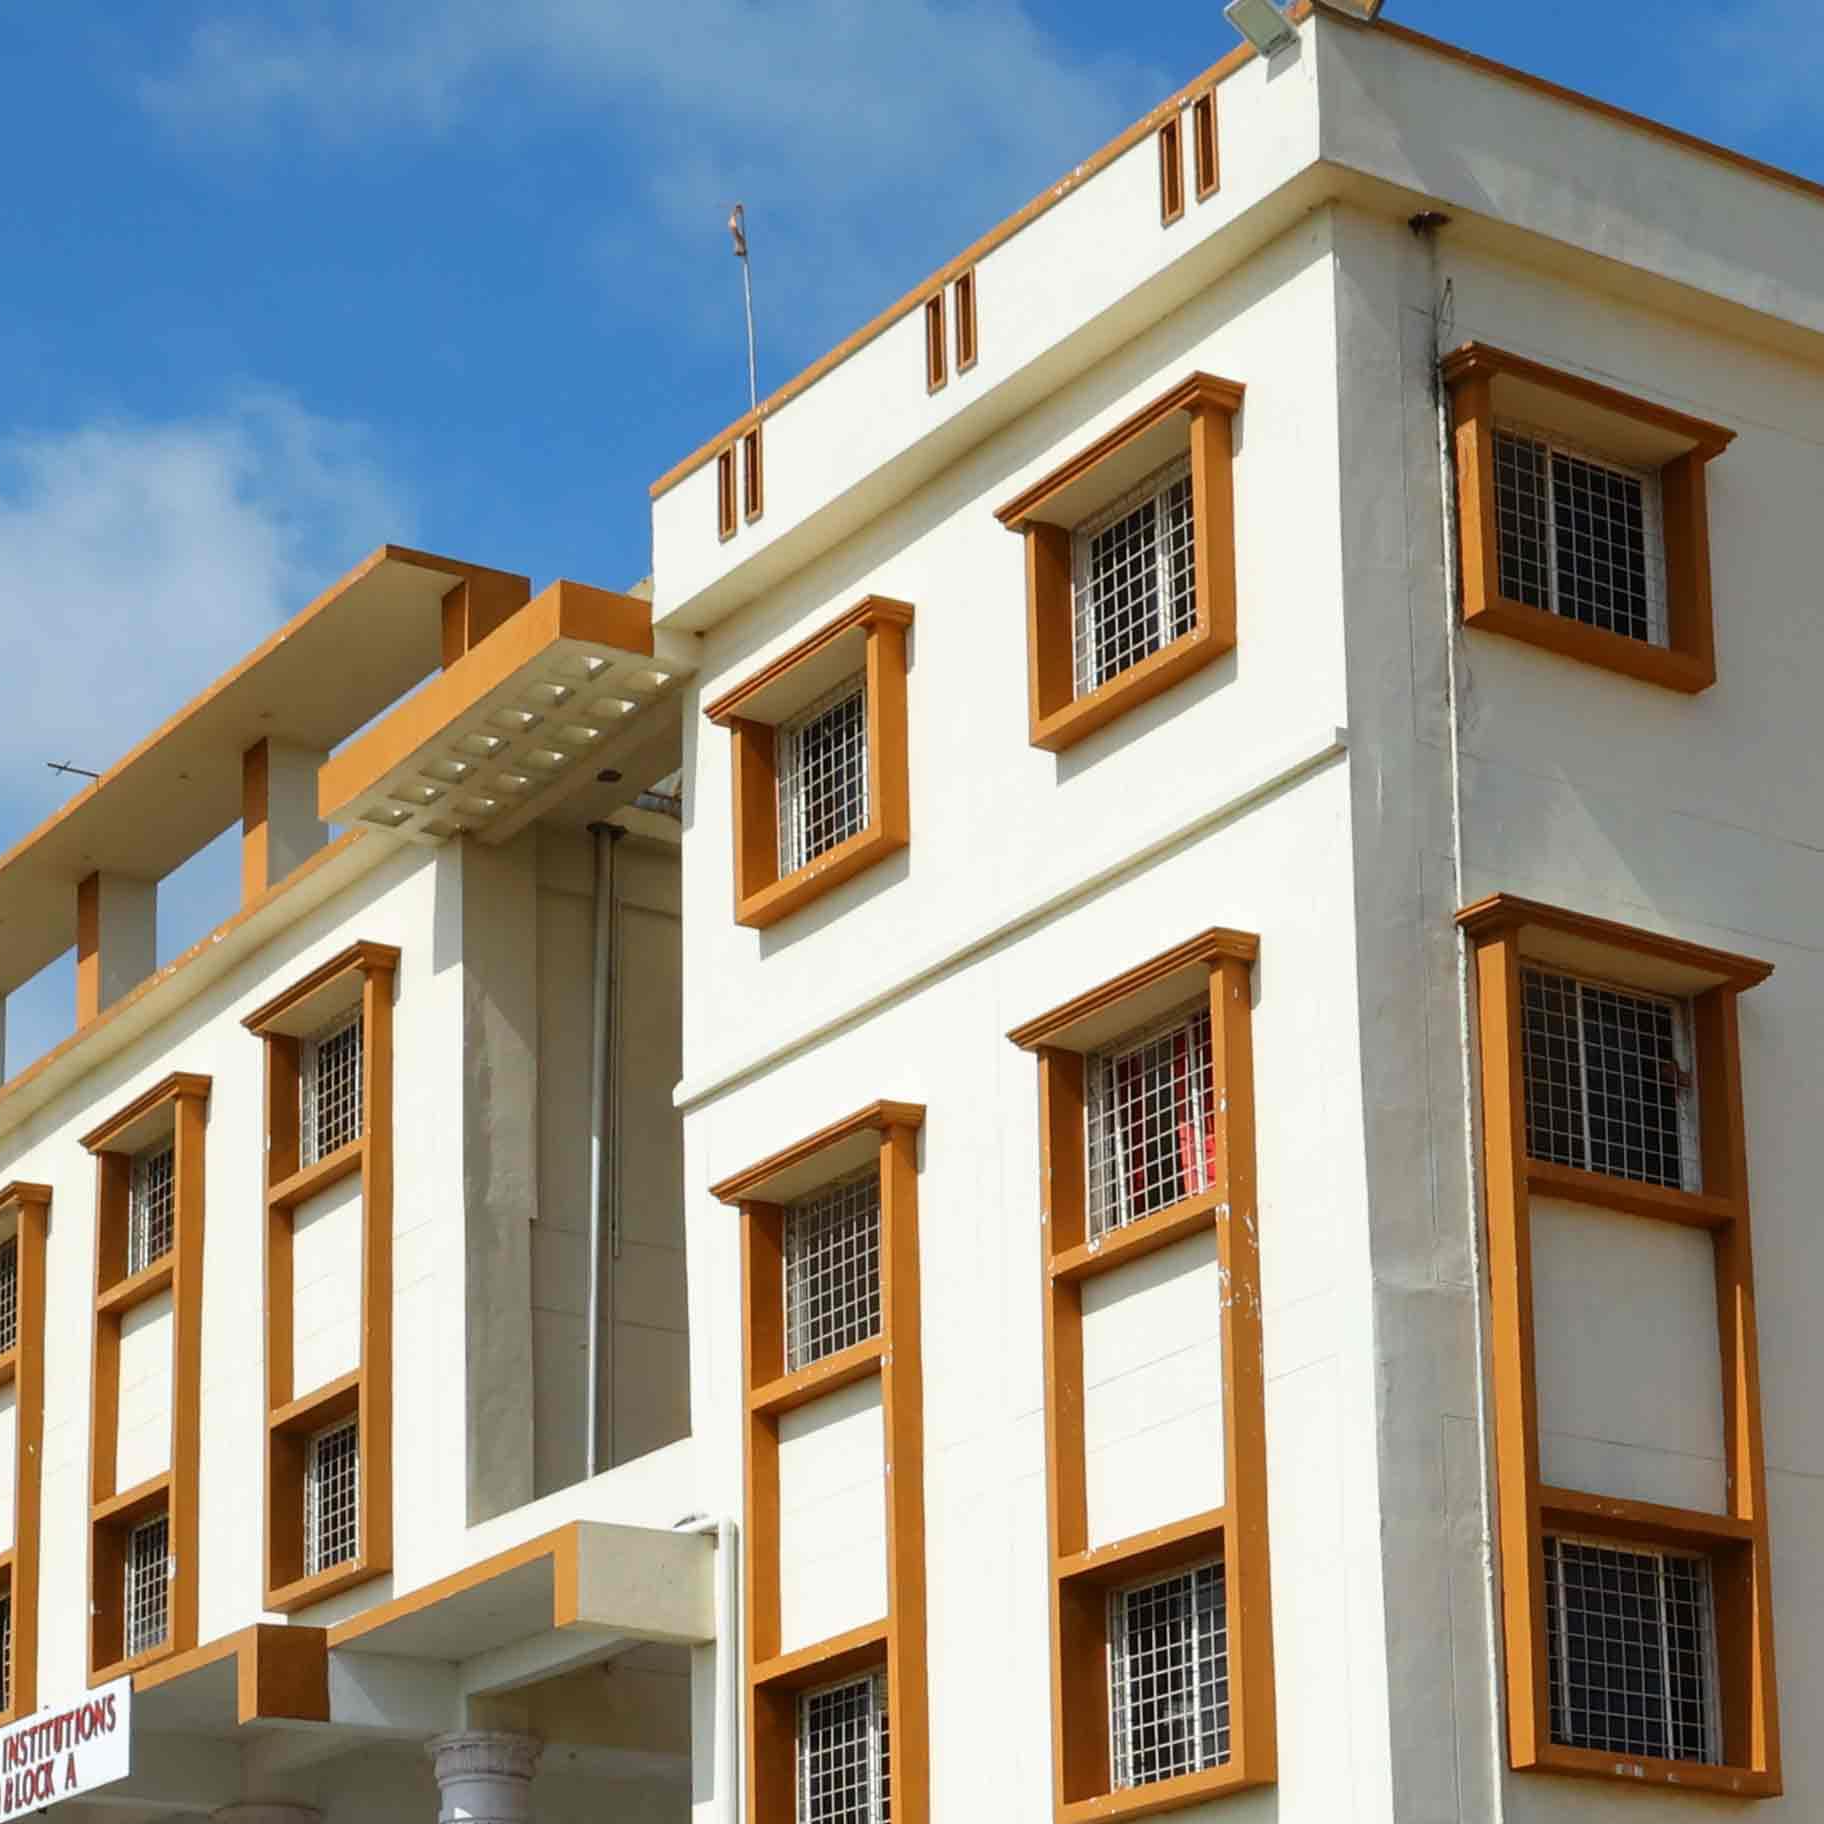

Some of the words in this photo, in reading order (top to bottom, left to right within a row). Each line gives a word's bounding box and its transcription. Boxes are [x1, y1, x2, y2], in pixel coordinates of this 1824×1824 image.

[2, 1692, 117, 1775] INSTITUTIONS
[3, 1758, 56, 1815] BLOCK
[63, 1751, 78, 1791] A
